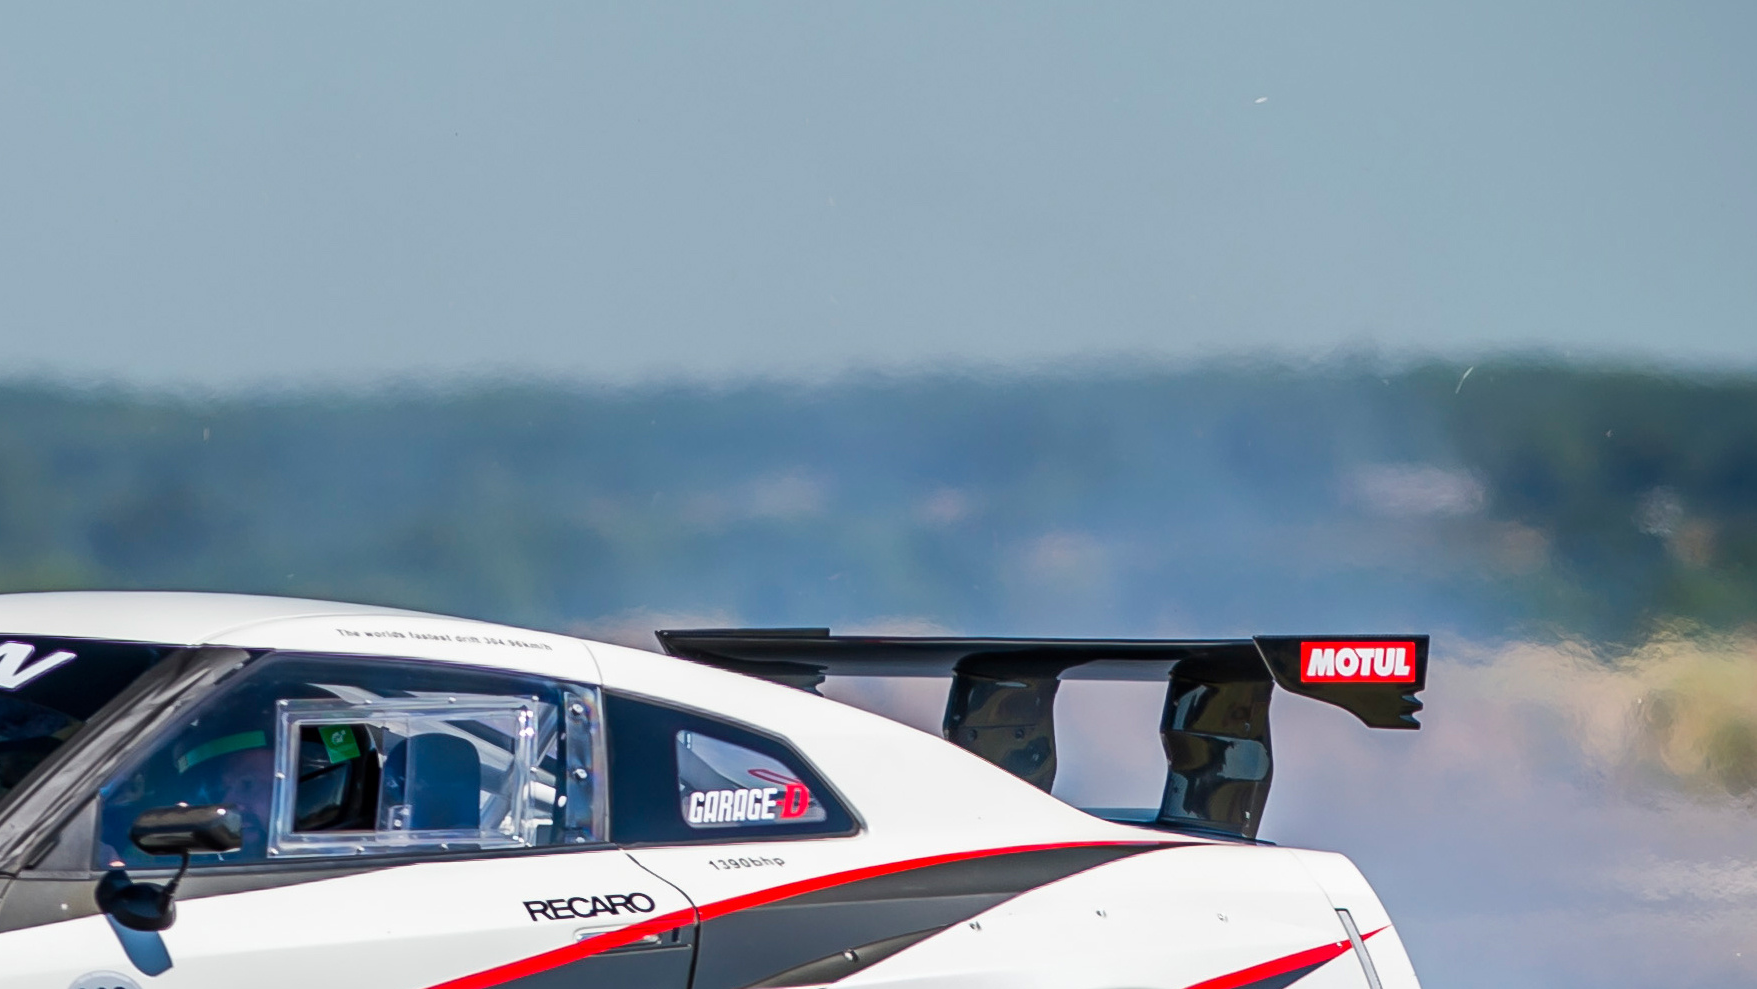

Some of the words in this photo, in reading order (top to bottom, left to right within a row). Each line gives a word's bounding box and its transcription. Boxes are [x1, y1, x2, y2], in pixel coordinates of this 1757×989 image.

[1307, 647, 1410, 677] MOTUL
[708, 856, 786, 871] 1390bhp
[522, 892, 656, 922] RECARO
